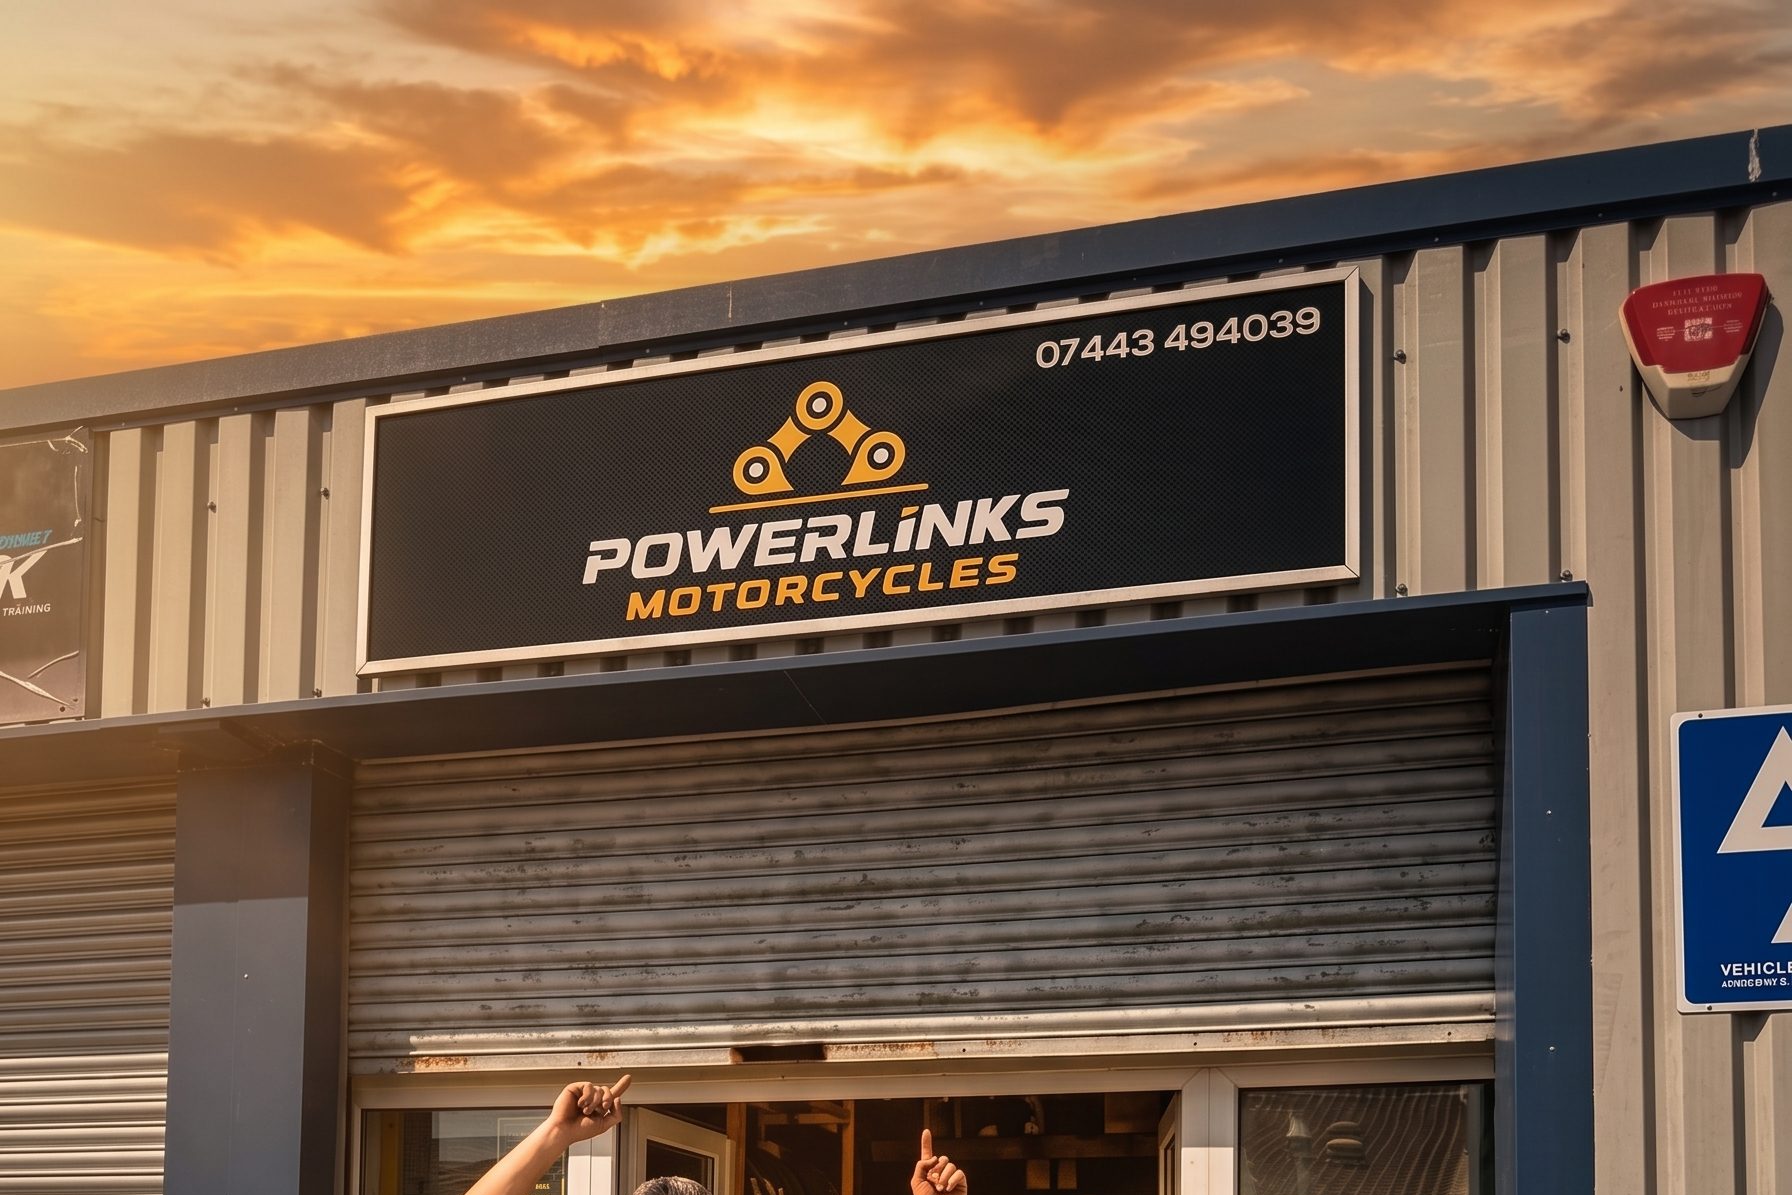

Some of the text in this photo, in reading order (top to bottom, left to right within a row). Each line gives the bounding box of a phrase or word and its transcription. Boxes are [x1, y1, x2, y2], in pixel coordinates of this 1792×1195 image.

[1035, 306, 1321, 369] 07443 494039
[2, 603, 51, 617] TRAINING
[626, 553, 1019, 621] MOTORCYCLES
